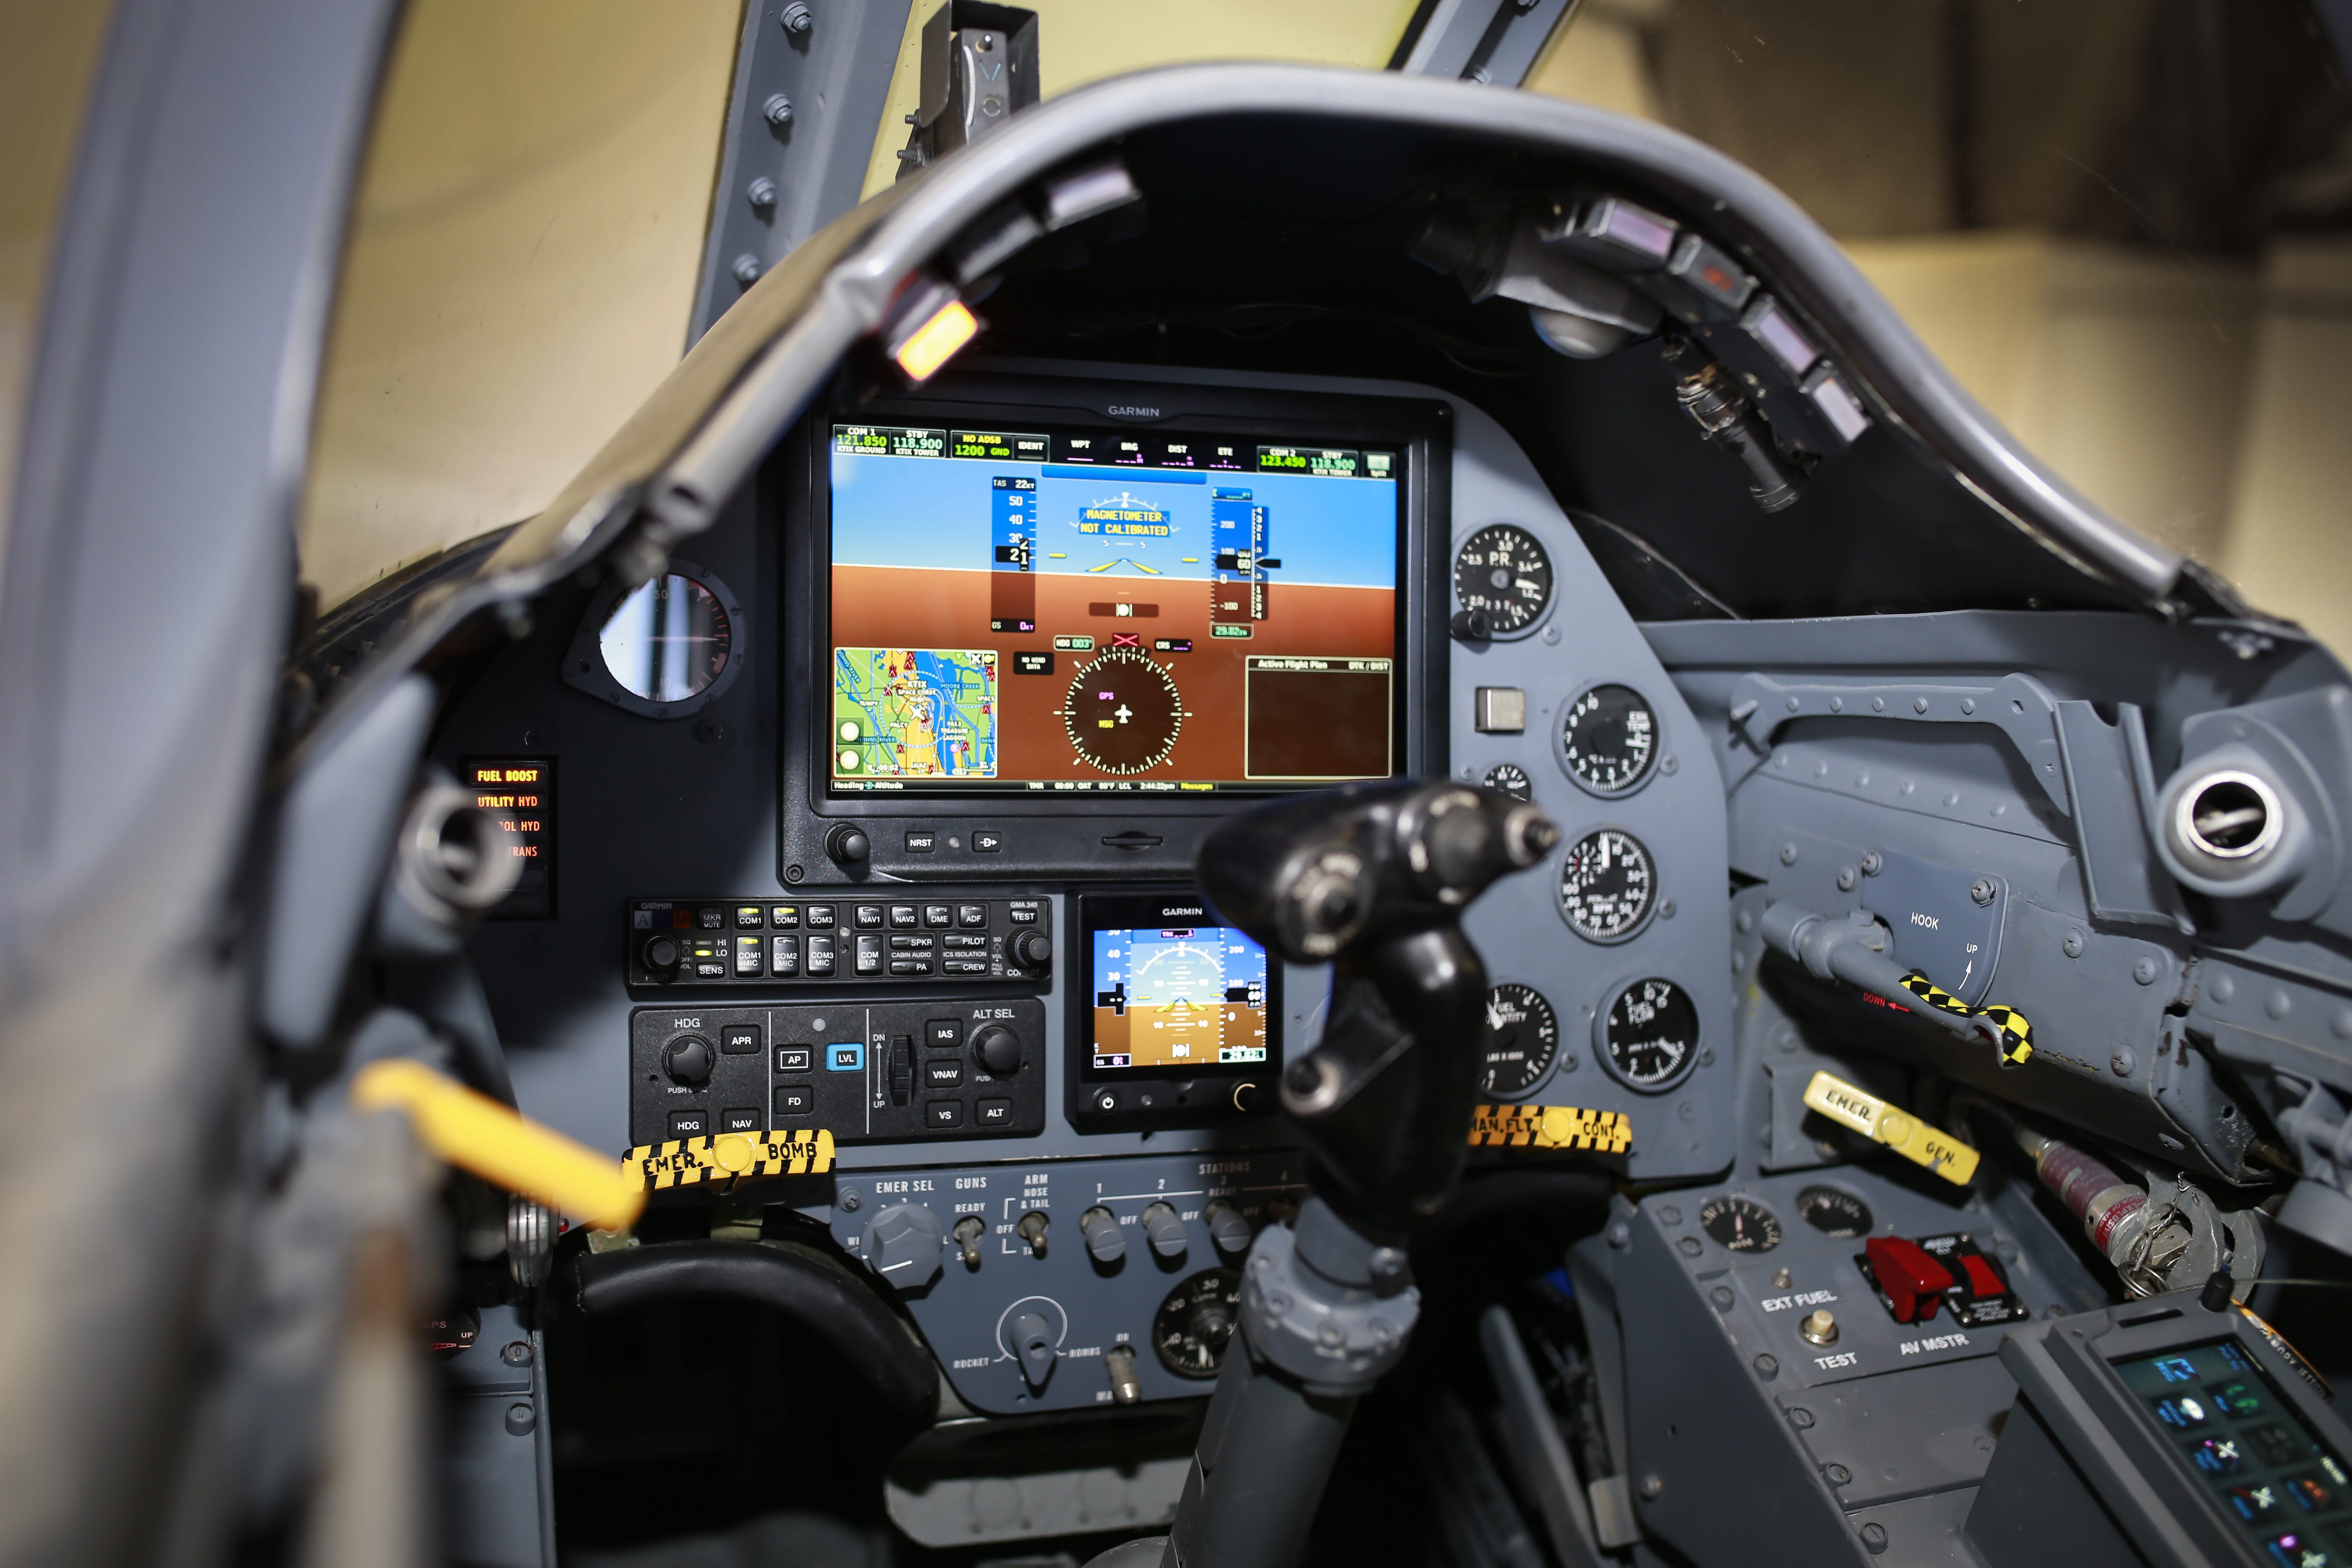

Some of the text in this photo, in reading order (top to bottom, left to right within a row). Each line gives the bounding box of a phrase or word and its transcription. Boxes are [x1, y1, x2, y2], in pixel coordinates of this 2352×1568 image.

[1108, 406, 1160, 417] GARMIN
[906, 430, 928, 438] STBY
[837, 434, 887, 446] 121.850
[893, 437, 943, 450] 118.900
[963, 435, 1001, 444] NO ADSB
[1071, 440, 1090, 448] WPT
[955, 445, 1009, 456] 1200 GND
[1018, 441, 1044, 451] IDENT
[1121, 442, 1138, 451] BRG
[1168, 445, 1187, 453] DIST
[1269, 448, 1289, 456] COM
[1260, 455, 1306, 467] 123.450
[1310, 457, 1356, 470] 118.900
[994, 479, 1007, 487] TAS
[1009, 496, 1023, 506] 50
[1009, 514, 1023, 525] 40
[1086, 509, 1162, 522] MAGNETOMETER
[1080, 523, 1169, 536] NOT CALIBRATED
[1220, 520, 1235, 529] 200
[1009, 533, 1023, 544] 30
[1237, 558, 1251, 569] 60
[654, 590, 668, 599] 30
[1056, 639, 1070, 647] HDG
[1258, 659, 1328, 671] Active Flight Plan
[907, 680, 927, 688] KTIX
[1098, 692, 1114, 700] GPS
[1098, 720, 1114, 729] MSG
[477, 770, 538, 782] FUEL BOOST
[834, 782, 864, 790] Heading
[477, 796, 538, 807] UTILITY HYD
[521, 821, 540, 831] HYD
[909, 838, 932, 848] NRST
[1162, 908, 1203, 916] GARMIN
[1911, 911, 1939, 931] HOOK
[911, 938, 932, 946] SPKR
[1229, 946, 1245, 954] 200
[1966, 943, 1978, 954] UP
[1107, 950, 1121, 959] 40
[699, 966, 723, 975] SENS
[1107, 972, 1121, 981] 30
[1248, 991, 1261, 1000] 60
[1863, 991, 1886, 1007] DOWN
[973, 1009, 1015, 1019] ALT SEL
[675, 1018, 701, 1029] HDG
[872, 1034, 885, 1042] DN
[937, 1029, 953, 1039] IAS
[731, 1037, 751, 1045] APR
[788, 1056, 801, 1064] AP
[838, 1054, 855, 1063] LVL
[932, 1070, 958, 1079] VNAV
[788, 1097, 801, 1106] FD
[938, 1112, 952, 1120] VS
[987, 1108, 1004, 1118] ALT
[677, 1122, 700, 1130] HDG
[732, 1120, 752, 1129] NAV
[642, 1142, 817, 1176] EMER. BOMB
[1199, 1161, 1251, 1175] STATIONS
[955, 1176, 987, 1189] GUNS
[1024, 1174, 1048, 1185] ARM
[1157, 1178, 1166, 1190] 2
[876, 1180, 935, 1194] EMER SEL
[1024, 1187, 1048, 1197] NOSE
[1096, 1183, 1102, 1194] 1
[1208, 1186, 1238, 1196] READY
[955, 1203, 985, 1213] READY
[1020, 1199, 1050, 1209] & TAIL
[1119, 1215, 1138, 1225] OFF
[1181, 1210, 1200, 1221] OFF
[996, 1224, 1015, 1234] OFF
[1761, 1289, 1838, 1313] EXT FUEL
[1115, 1333, 1130, 1342] ON
[1900, 1333, 1970, 1355] AV MSTR
[1068, 1347, 1102, 1358] BOMBS
[953, 1357, 990, 1369] ROCKET
[1814, 1351, 1857, 1370] TEST
